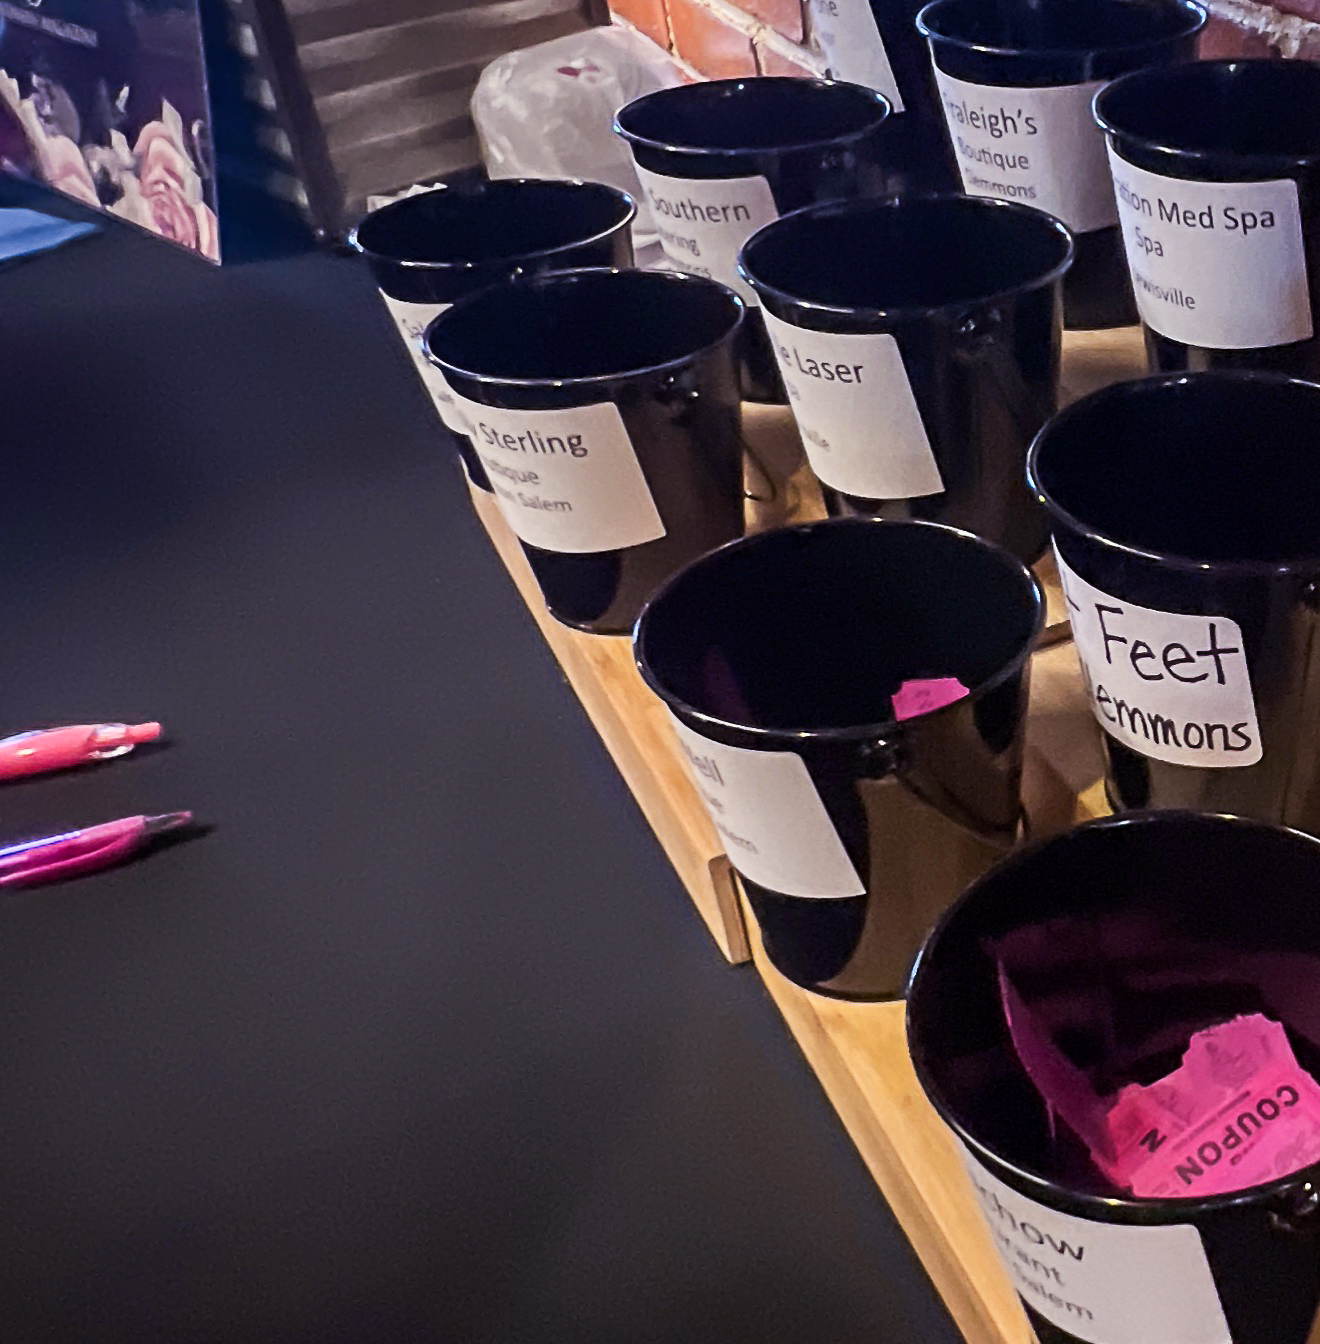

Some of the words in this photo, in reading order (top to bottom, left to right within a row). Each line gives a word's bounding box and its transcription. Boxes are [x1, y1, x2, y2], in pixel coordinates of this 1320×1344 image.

[1157, 198, 1215, 230] Med
[1223, 206, 1276, 236] Spa
[1135, 226, 1164, 258] Spa
[793, 346, 864, 384] Laser
[479, 422, 589, 458] Sterling
[1095, 602, 1240, 685] Feet
[1095, 684, 1253, 752] emmons
[1174, 1084, 1300, 1185] COUPON
